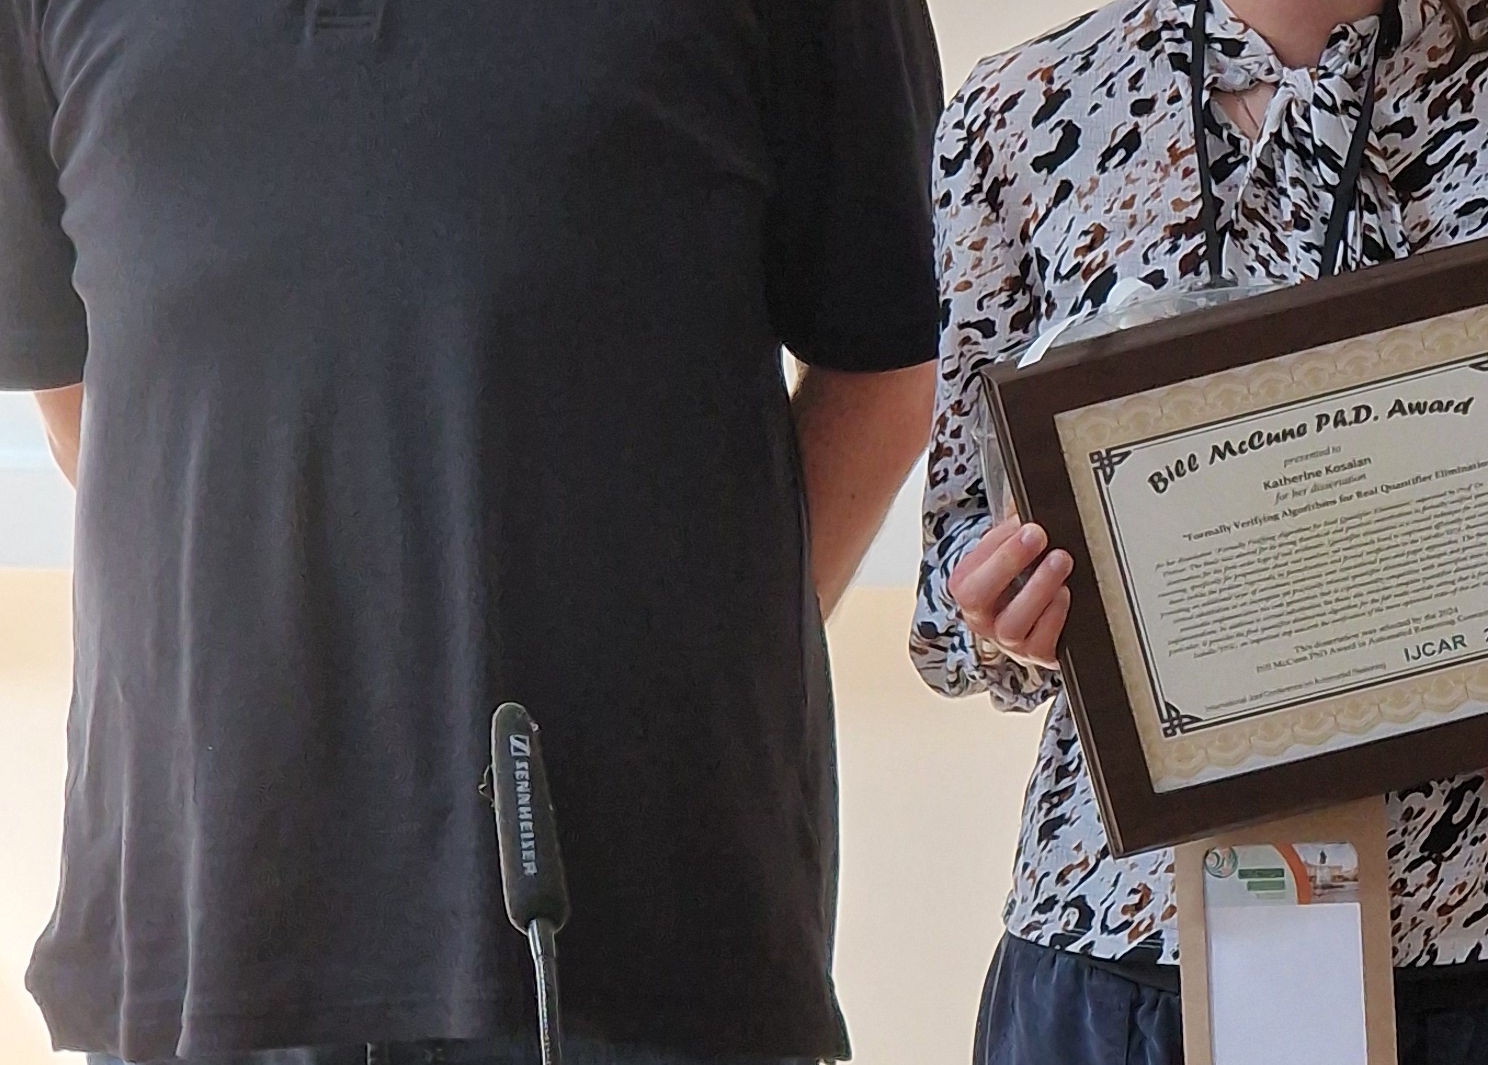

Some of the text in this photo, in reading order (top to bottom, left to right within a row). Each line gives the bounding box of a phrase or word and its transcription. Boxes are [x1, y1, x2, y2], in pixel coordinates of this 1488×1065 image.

[1147, 396, 1474, 493] Bill McCune Ph.D. Award
[1262, 469, 1322, 490] Katherine
[1403, 634, 1467, 661] IJCAR
[514, 760, 538, 877] SENNHEISER
